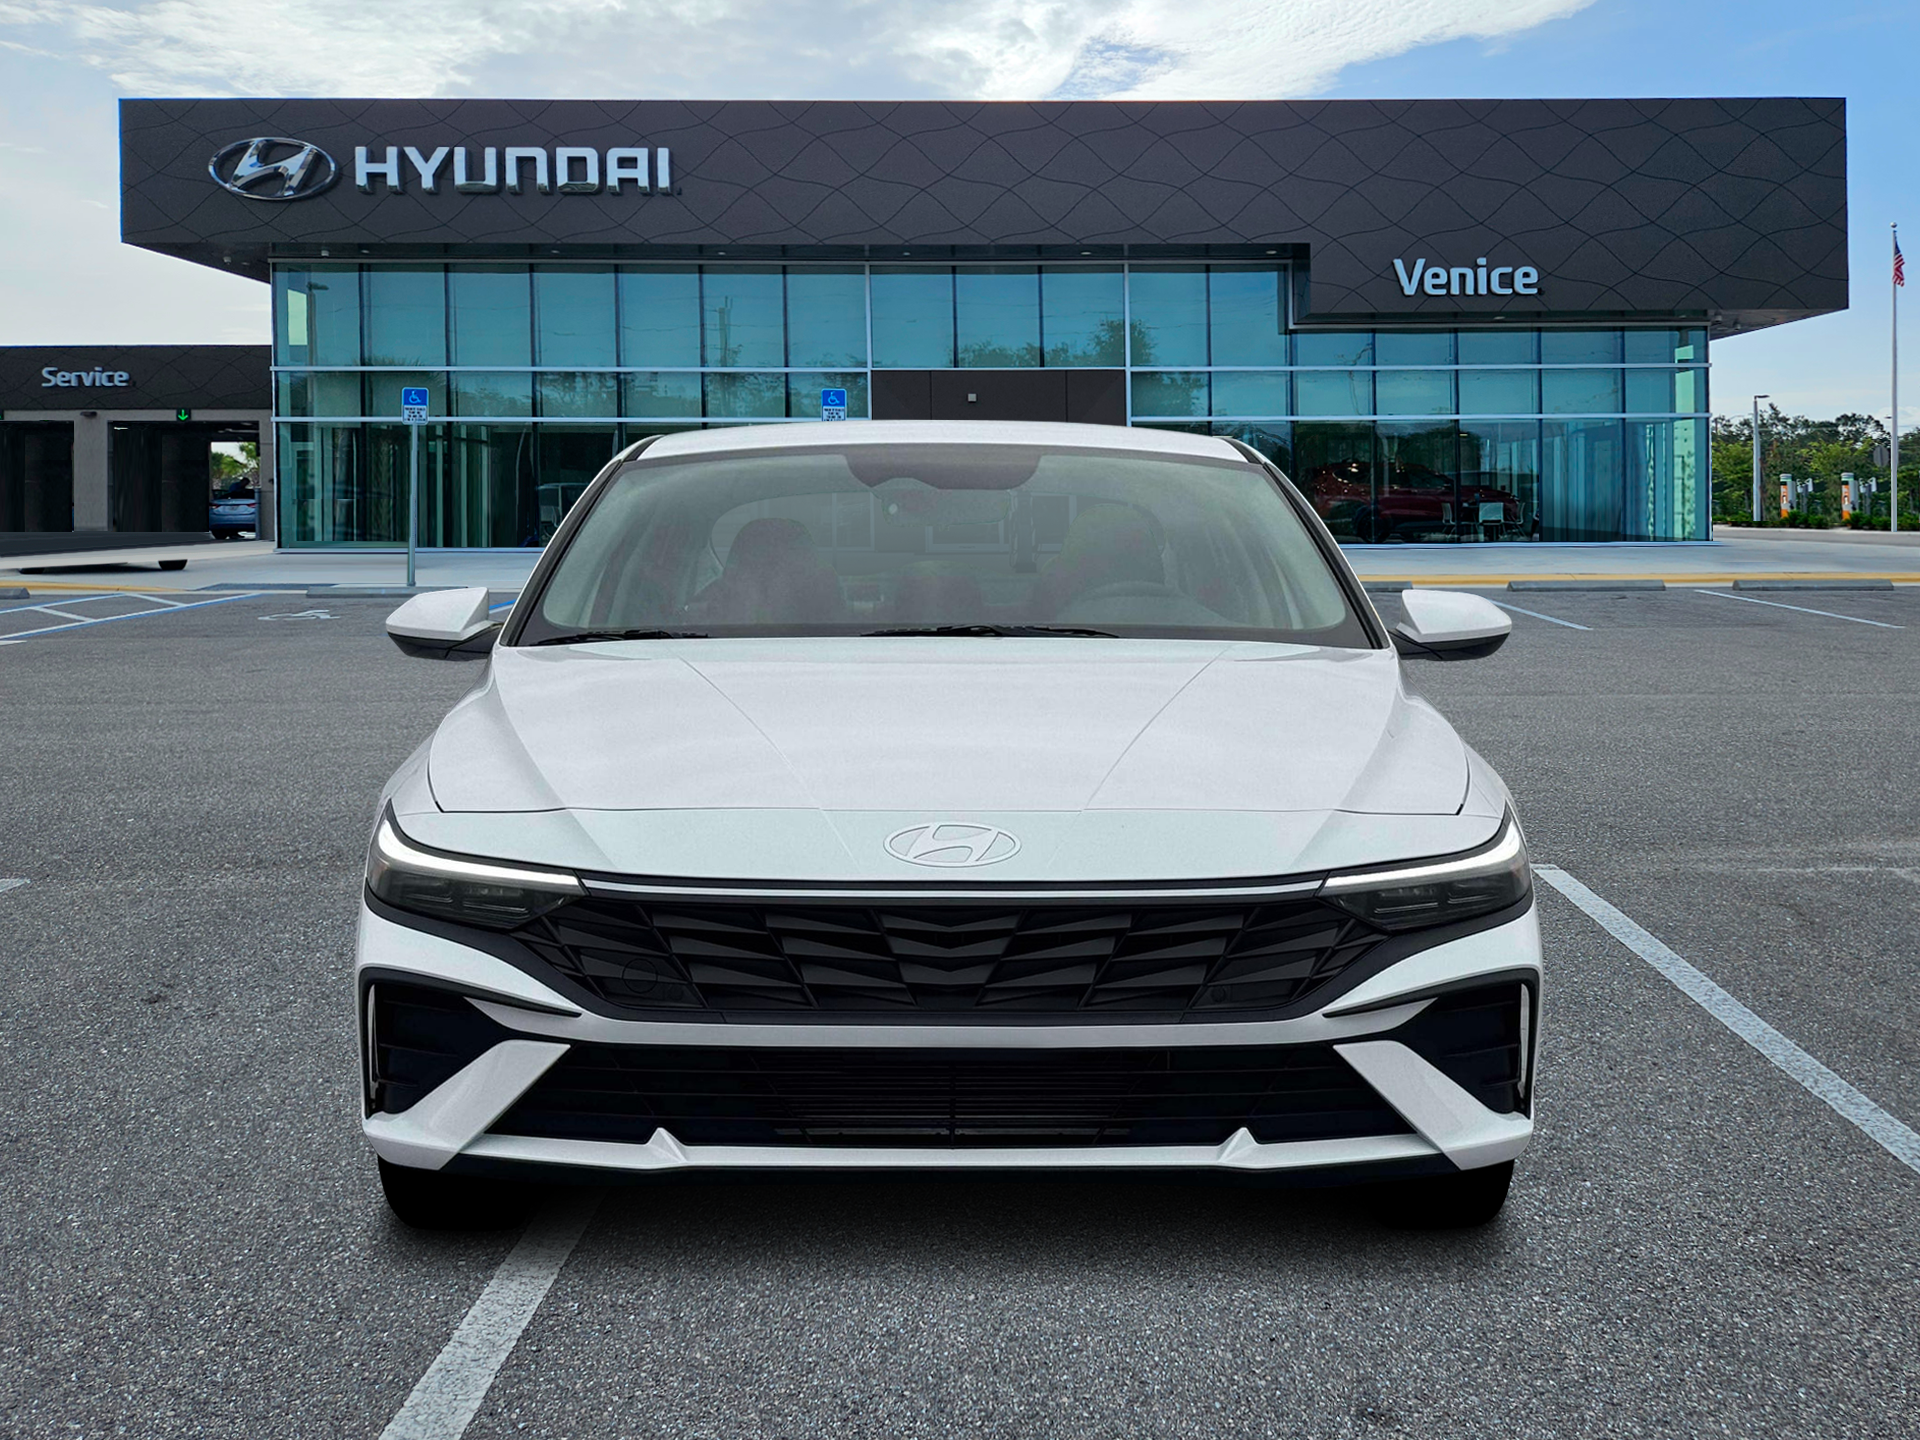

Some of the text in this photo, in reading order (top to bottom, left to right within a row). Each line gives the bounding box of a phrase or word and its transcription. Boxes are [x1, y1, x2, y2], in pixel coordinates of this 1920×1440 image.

[354, 146, 670, 194] HYUNDAI
[1393, 257, 1539, 296] Venice
[41, 366, 130, 388] Service
